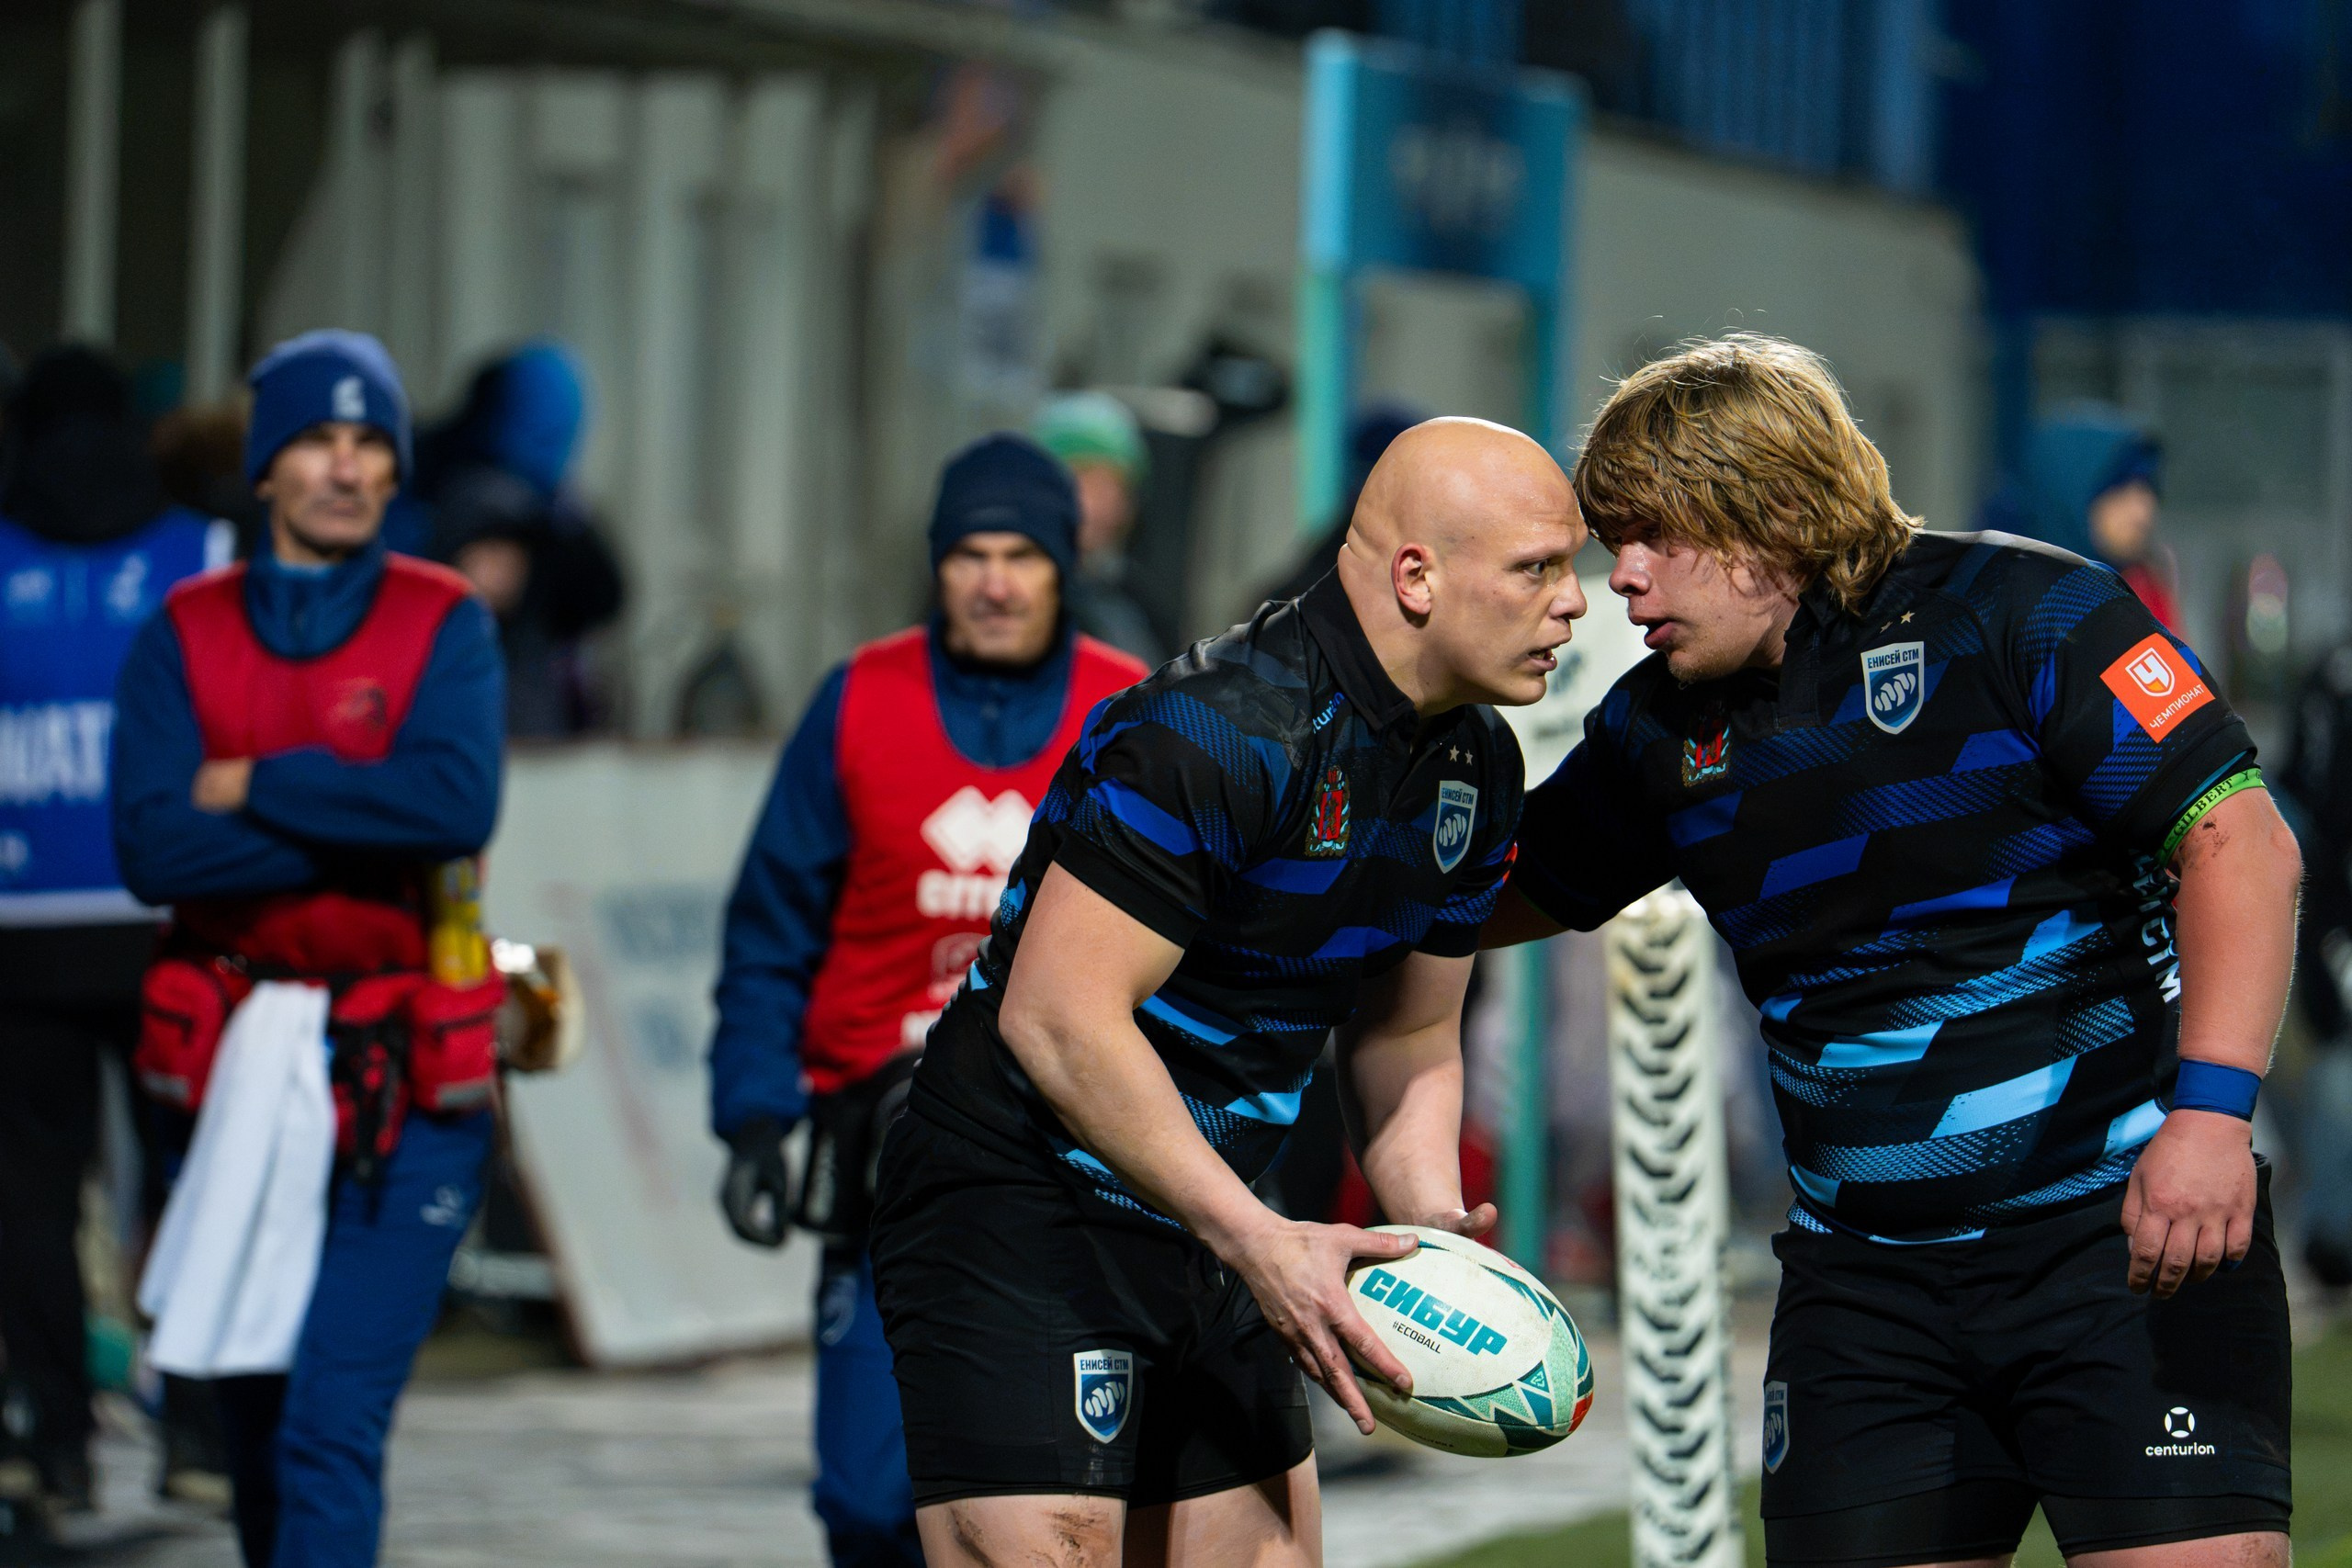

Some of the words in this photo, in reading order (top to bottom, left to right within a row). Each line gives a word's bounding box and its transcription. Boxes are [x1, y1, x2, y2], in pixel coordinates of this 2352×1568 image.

[1867, 649, 1901, 669] ЕНИСЕЙ
[1902, 648, 1919, 662] СТМ
[2149, 683, 2204, 728] ЧЕМПИОНАТ
[2173, 778, 2233, 836] GILBERT
[1359, 1268, 1508, 1356] СИБУР
[1392, 1320, 1442, 1354] #ECOBALL
[1080, 1356, 1113, 1371] ЕНИСЕЙ
[1114, 1359, 1129, 1371] СТМ
[2145, 1442, 2215, 1456] centurion
